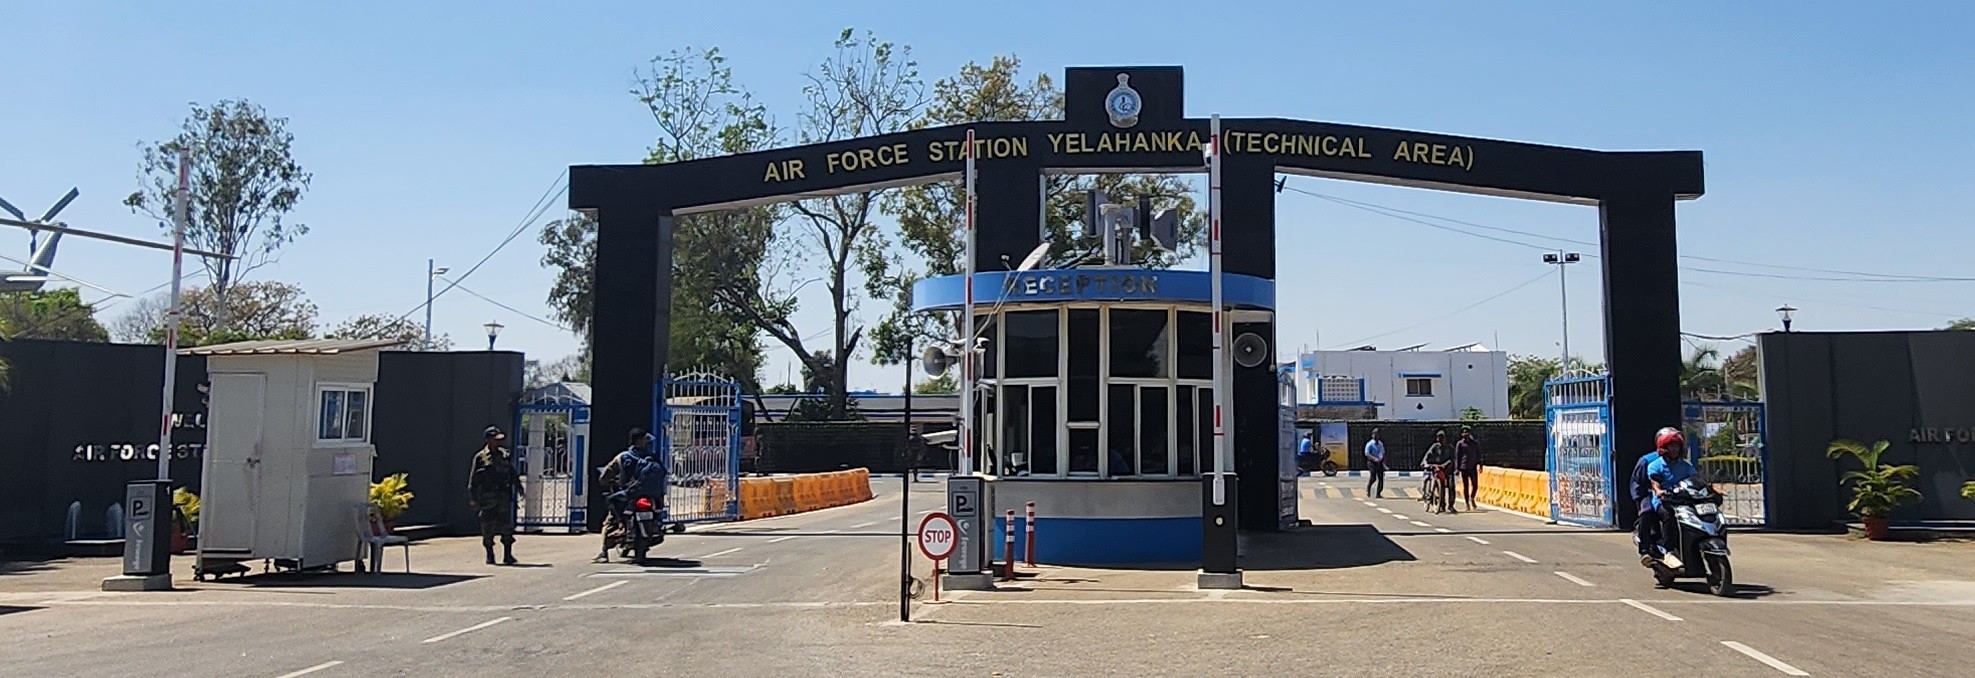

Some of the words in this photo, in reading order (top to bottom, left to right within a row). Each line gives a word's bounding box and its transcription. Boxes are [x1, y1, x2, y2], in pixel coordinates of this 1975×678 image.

[763, 161, 806, 182] AIR
[827, 143, 909, 174] FORCE
[928, 136, 1028, 162] STATION
[1047, 131, 1202, 154] YELAHANKA
[1223, 129, 1371, 158] (TECHNICAL
[1394, 140, 1474, 171] AREA)
[1005, 274, 1159, 296] RECEPTION
[170, 413, 206, 428] WEL
[1909, 427, 1940, 442] AIR
[1943, 427, 1975, 443] FO
[73, 444, 106, 461] AIR
[176, 443, 205, 459] ST
[924, 529, 952, 543] STOP
